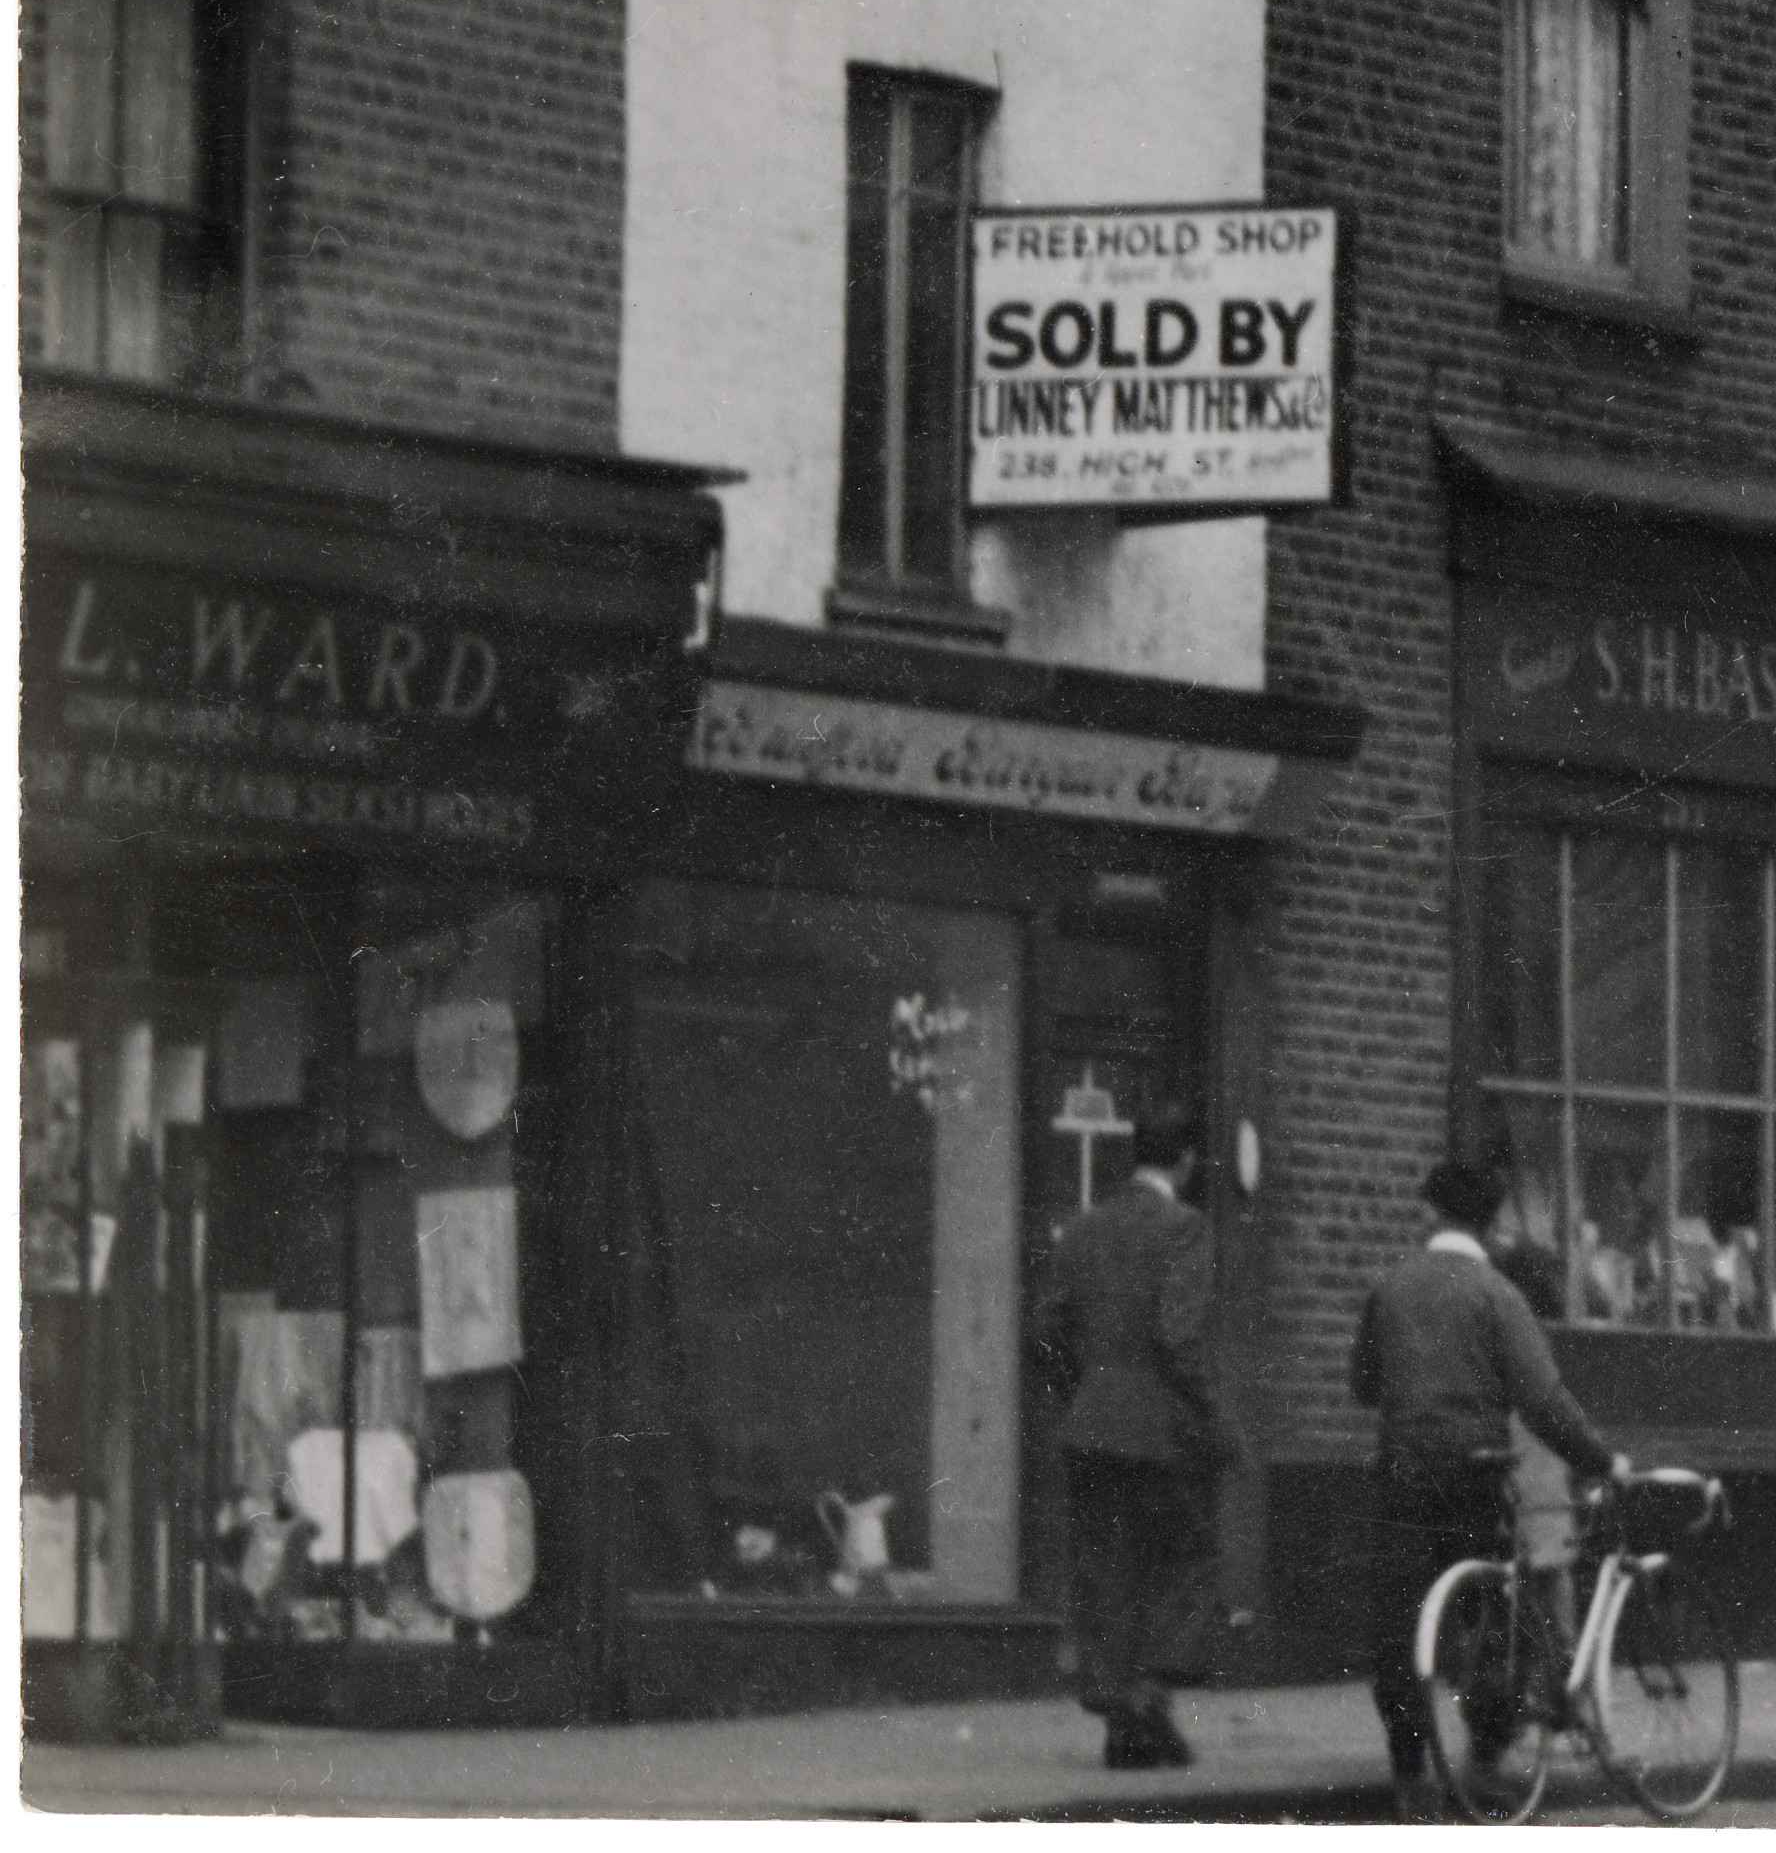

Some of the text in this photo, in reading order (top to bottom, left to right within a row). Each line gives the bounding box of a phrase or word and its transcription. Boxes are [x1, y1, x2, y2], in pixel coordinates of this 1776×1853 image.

[990, 217, 1323, 260] FREEHOLD SHOP
[985, 298, 1316, 369] SOLD BY
[977, 374, 1101, 439] LINNEY
[56, 579, 140, 682] L.
